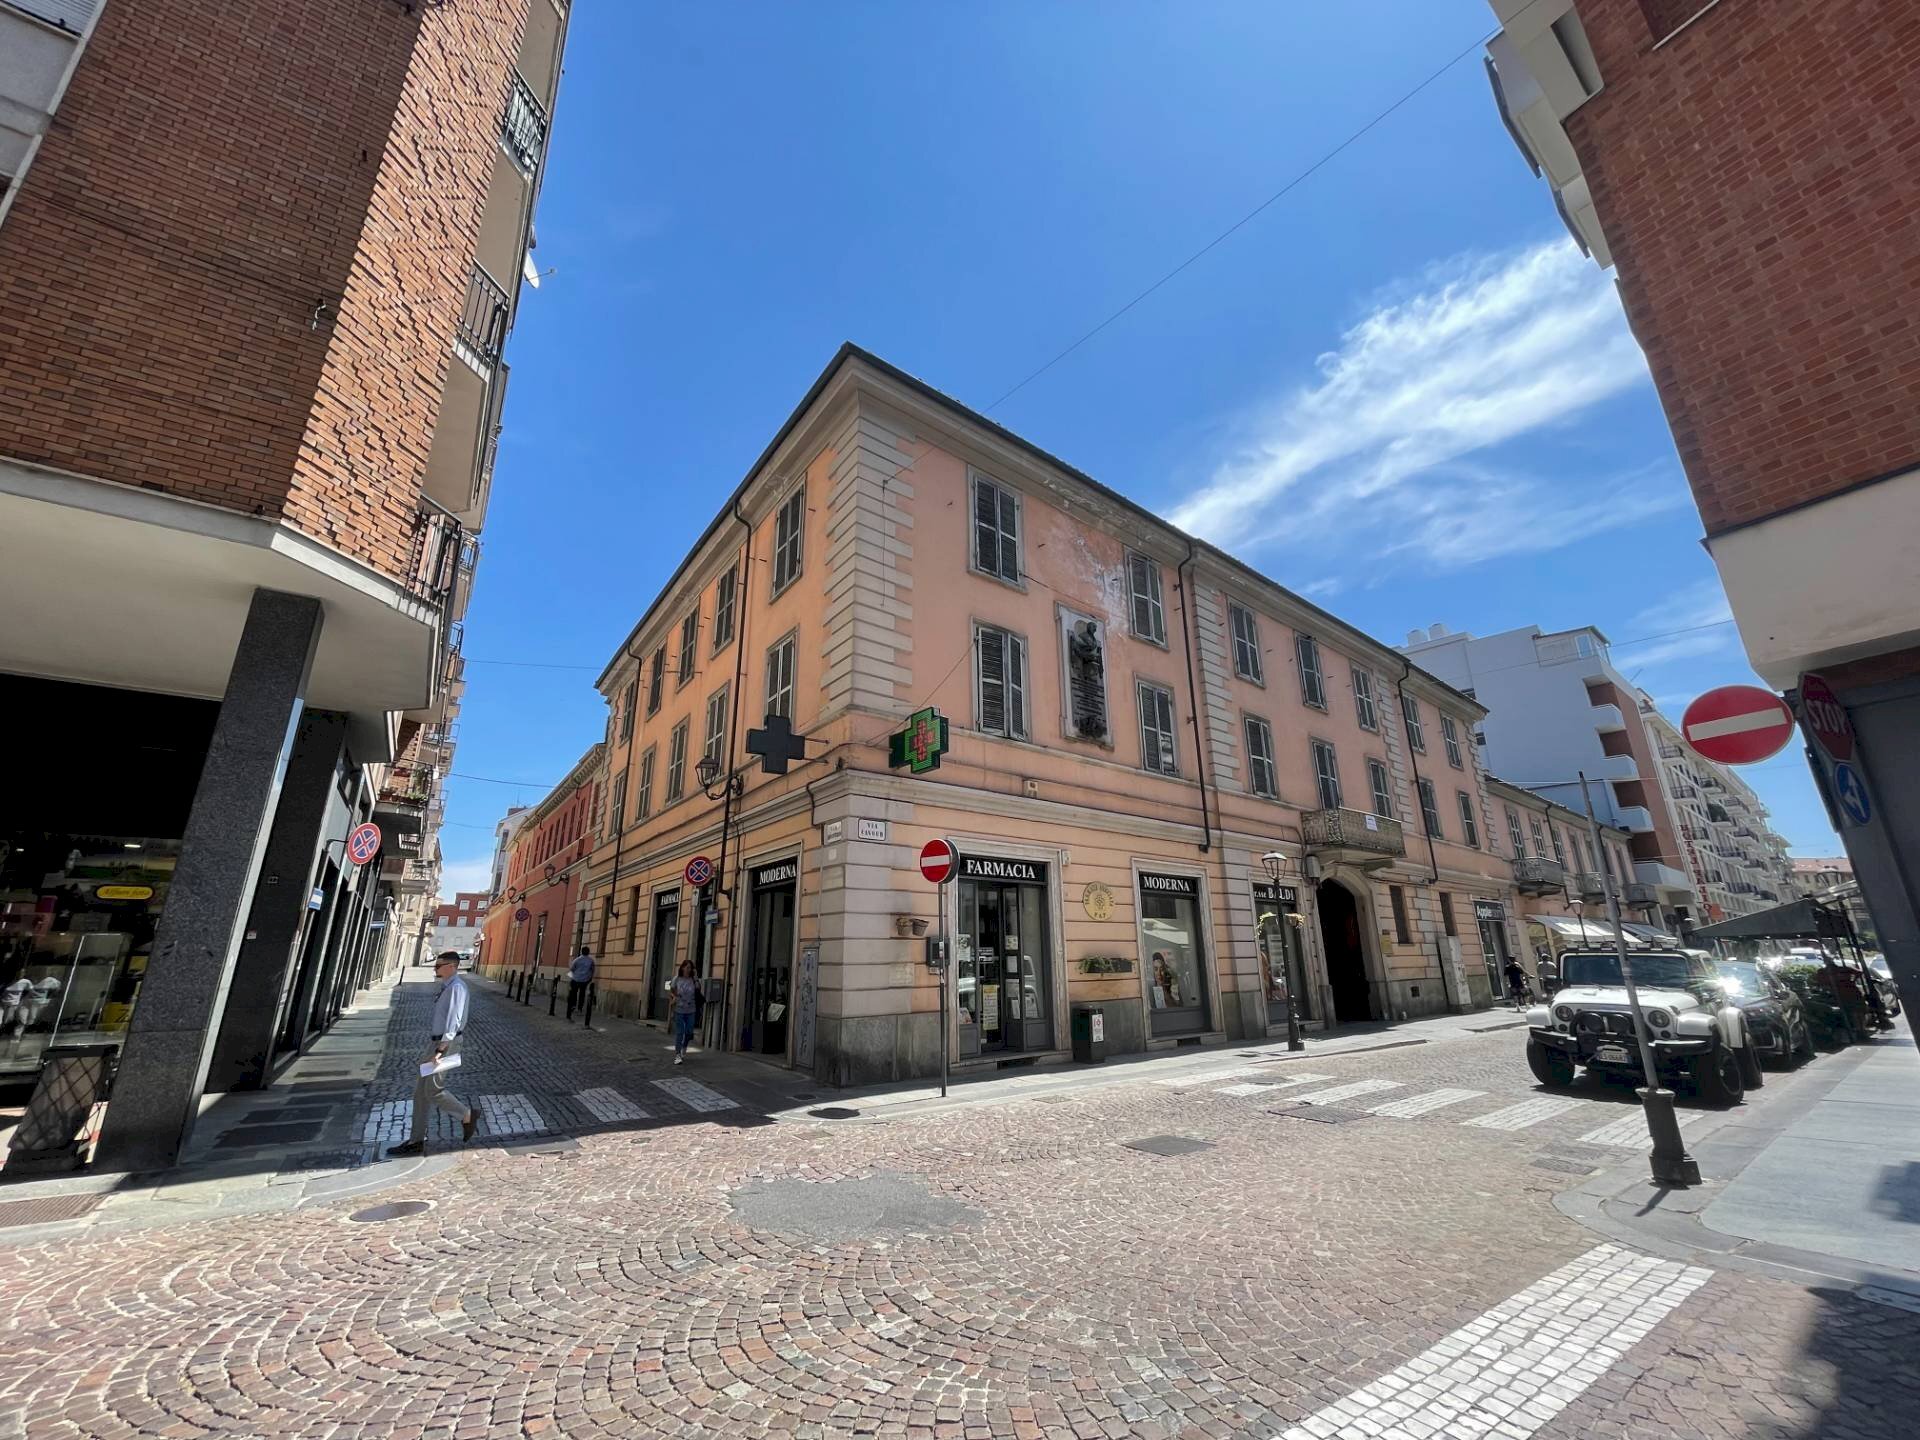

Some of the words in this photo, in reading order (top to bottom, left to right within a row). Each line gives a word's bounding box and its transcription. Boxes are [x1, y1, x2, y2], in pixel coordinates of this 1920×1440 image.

[1805, 698, 1848, 735] STOP
[760, 864, 796, 885] MODERNA
[966, 859, 1036, 879] FARMACIA
[1143, 876, 1191, 892] MODERNA
